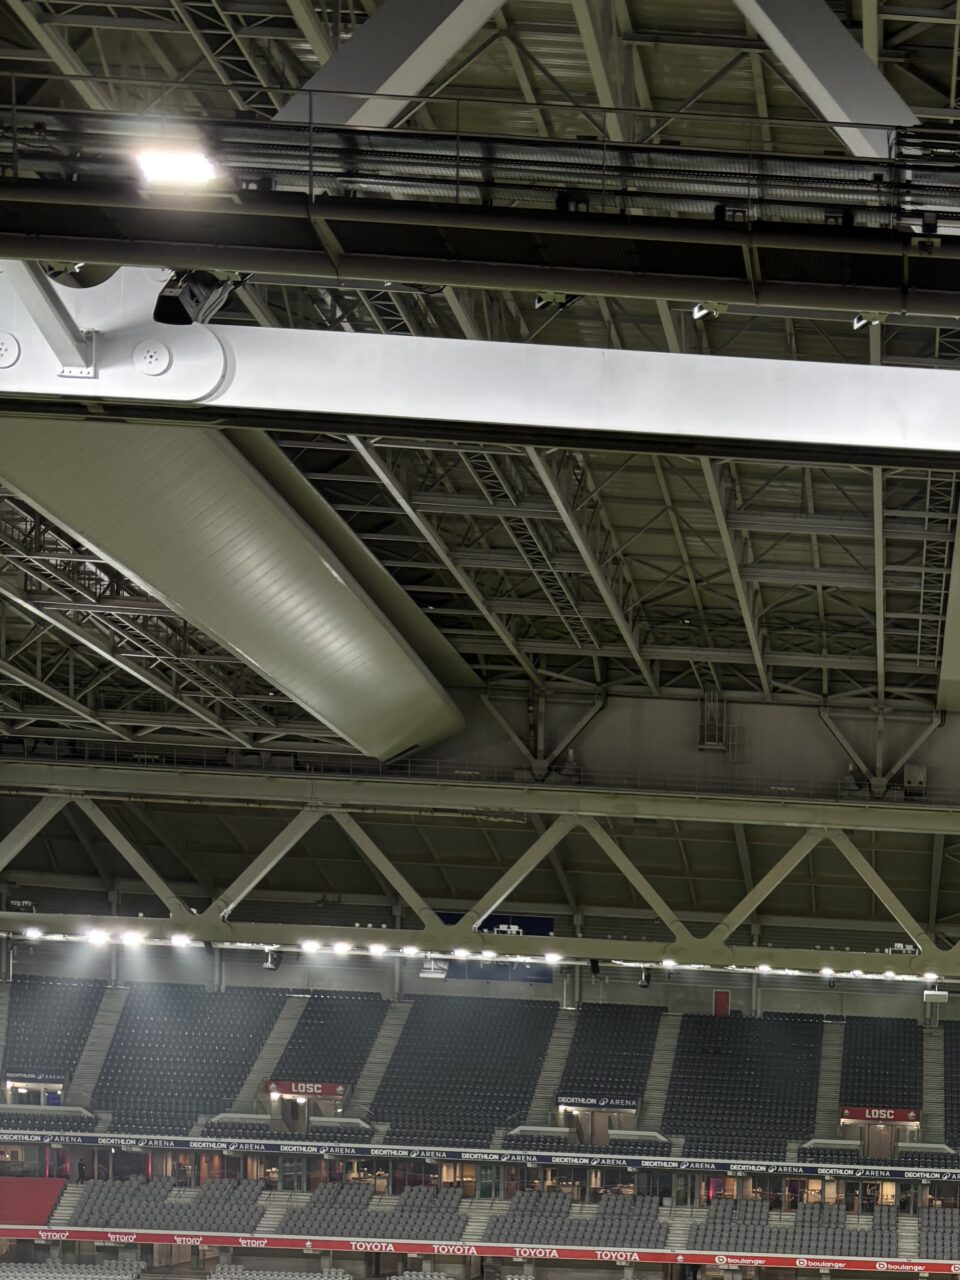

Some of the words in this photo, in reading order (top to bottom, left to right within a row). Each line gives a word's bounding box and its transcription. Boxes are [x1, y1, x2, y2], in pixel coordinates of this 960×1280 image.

[292, 1082, 322, 1092] LOSC
[866, 1109, 894, 1119] LOSC
[0, 1134, 40, 1142] DECATHLON
[98, 1137, 136, 1146] DECATHLON
[190, 1141, 226, 1149] DECATHLON
[239, 1143, 265, 1151] ARENA
[280, 1144, 317, 1153] DECATHLON
[371, 1148, 408, 1156] DECATHLON
[421, 1150, 446, 1158] ARENA
[462, 1152, 499, 1160] DECATHLON
[511, 1154, 537, 1162] ARENA
[552, 1156, 589, 1164] DECATHLON
[601, 1158, 627, 1166] ARENA
[641, 1160, 678, 1168] DECATHLON
[690, 1162, 715, 1170] ARENA
[730, 1163, 766, 1172] DECATHLON
[818, 1167, 853, 1175] DECATHLON
[865, 1169, 890, 1177] ARENA
[905, 1170, 940, 1179] DECATHLON
[350, 1242, 395, 1252] TOYOTA
[433, 1245, 477, 1255] TOYOTA
[514, 1248, 559, 1258] TOYOTA
[596, 1251, 640, 1261] TOYOTA
[728, 1258, 766, 1266] boulanger
[808, 1260, 846, 1268] boulanger
[888, 1263, 926, 1271] boulanger
